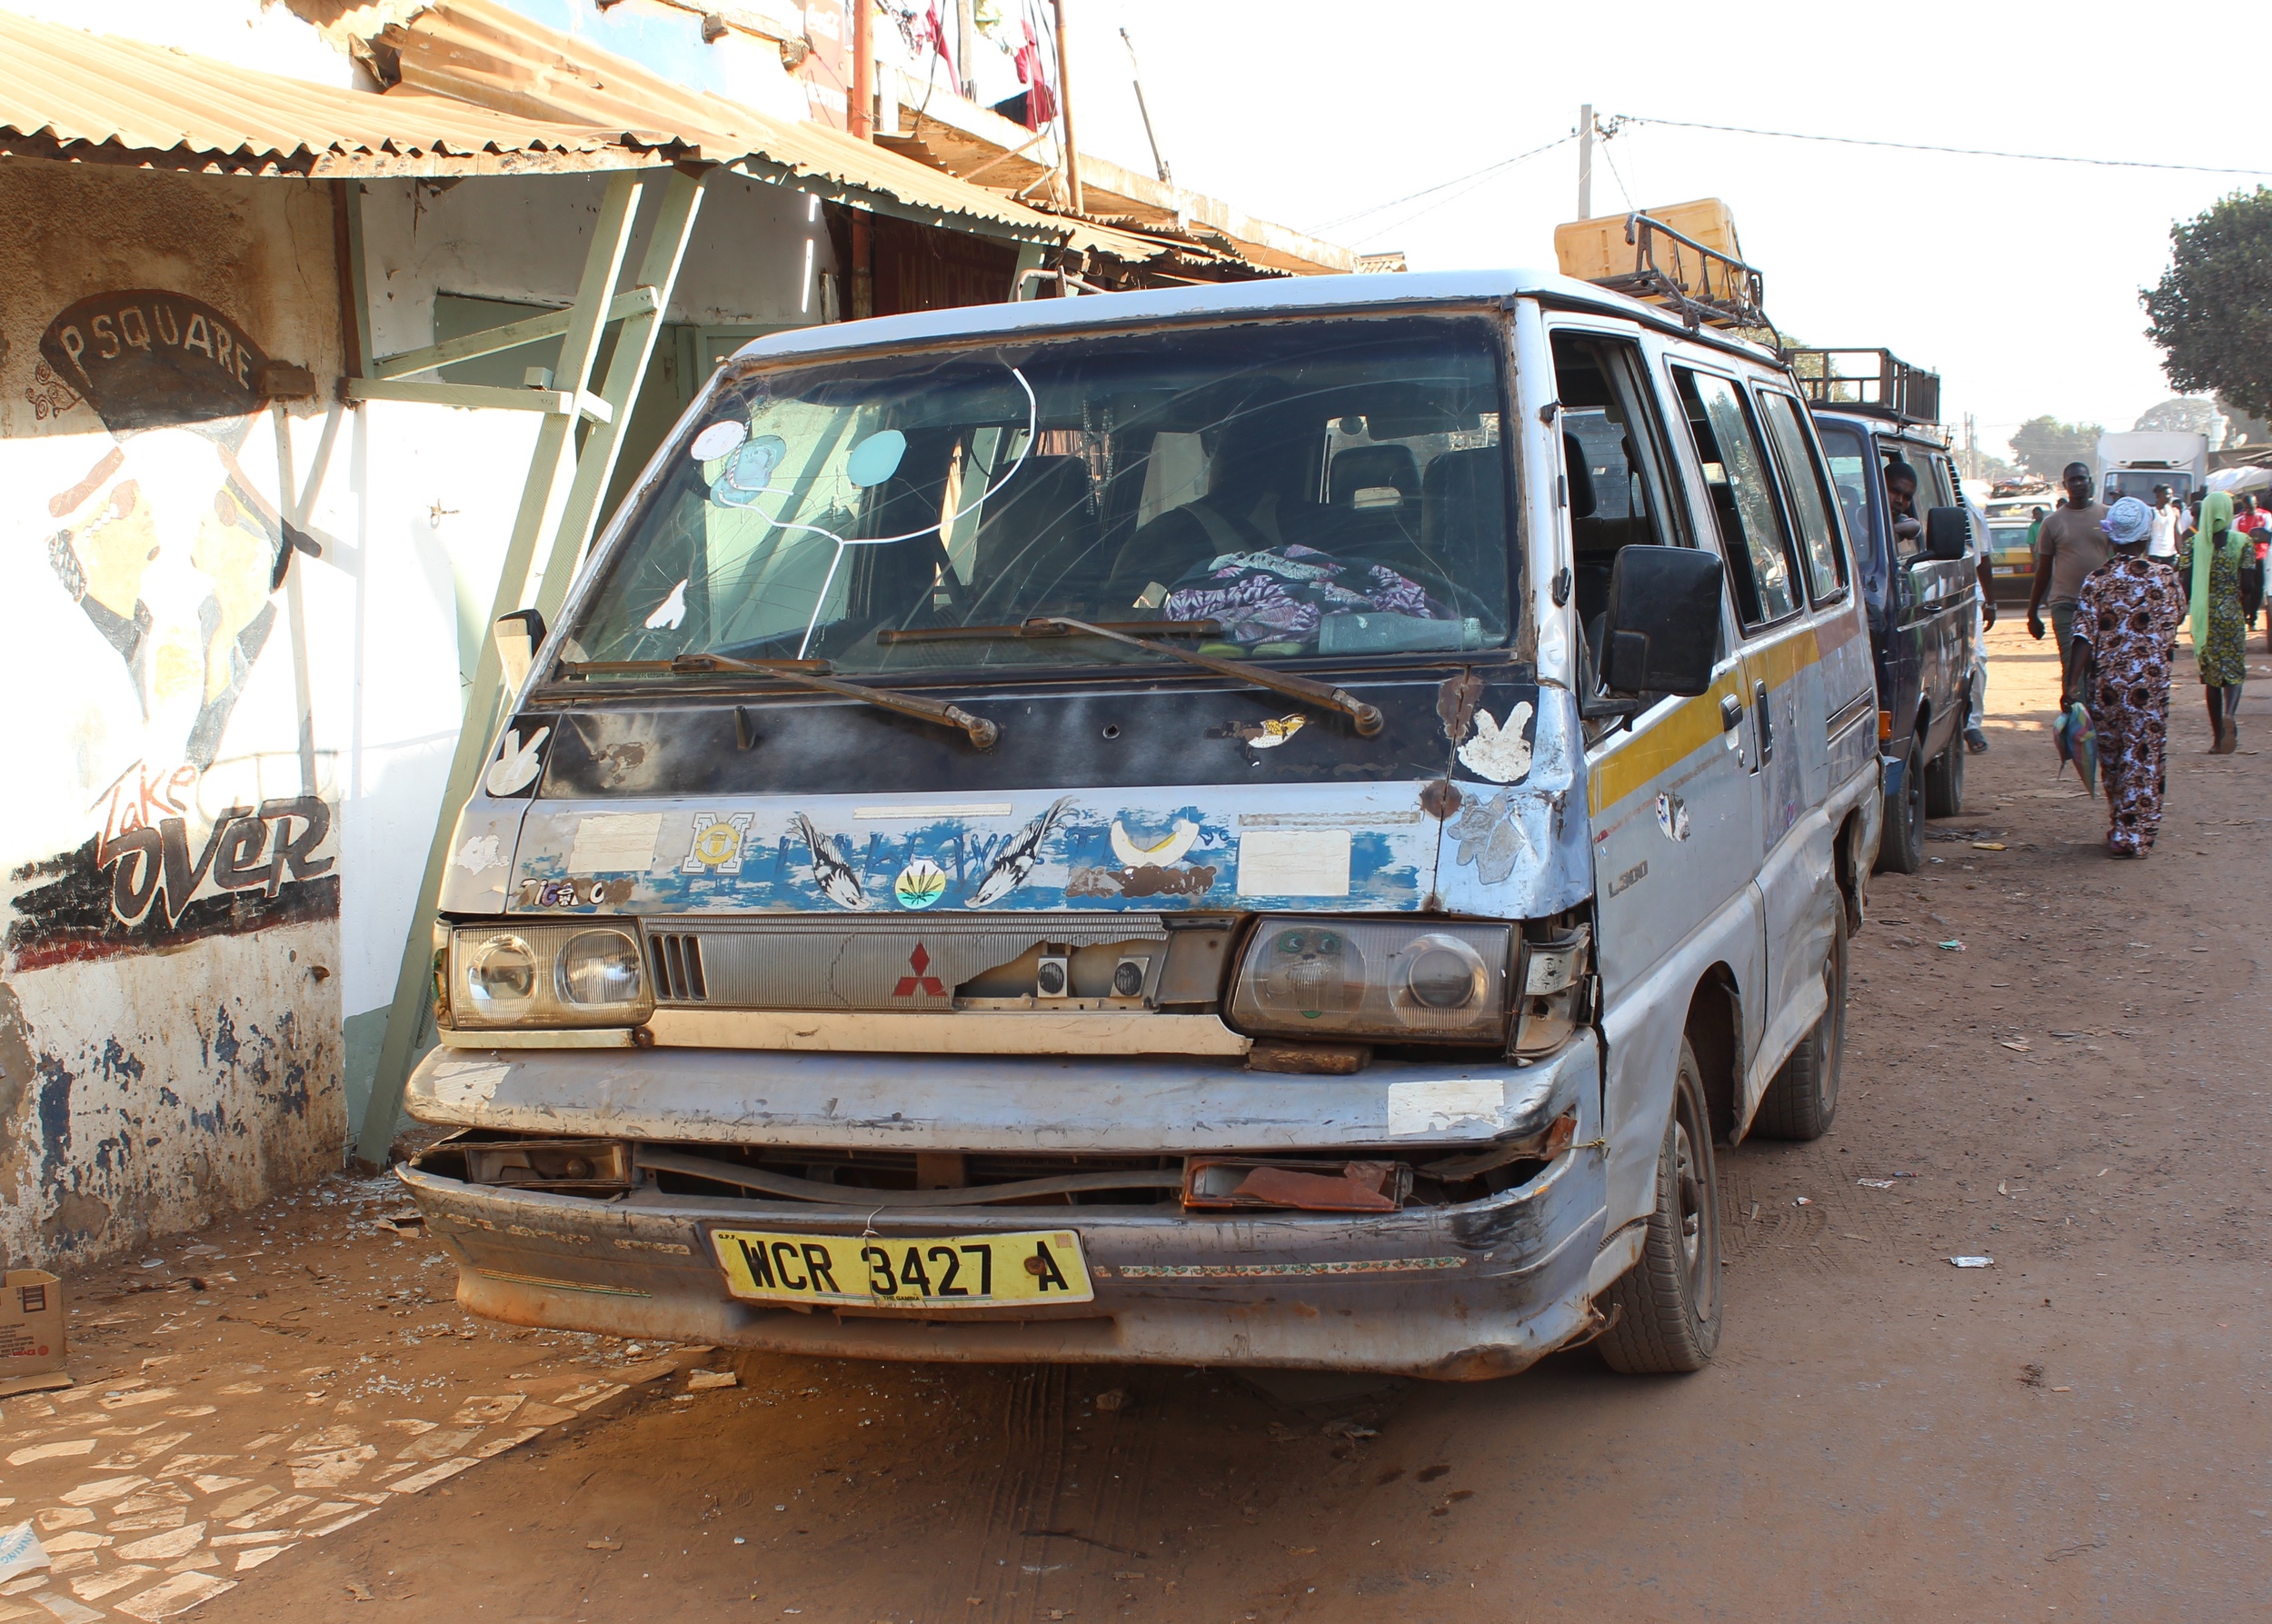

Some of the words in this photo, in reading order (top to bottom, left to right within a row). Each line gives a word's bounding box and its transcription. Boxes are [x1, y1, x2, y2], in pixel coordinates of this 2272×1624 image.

[60, 325, 93, 389] P
[92, 304, 252, 390] SQUARE
[1607, 859, 1649, 899] L300
[737, 1239, 841, 1292] WCR
[861, 1244, 992, 1296] 3427
[1035, 1240, 1069, 1291] A
[1, 1529, 35, 1564] INKING
